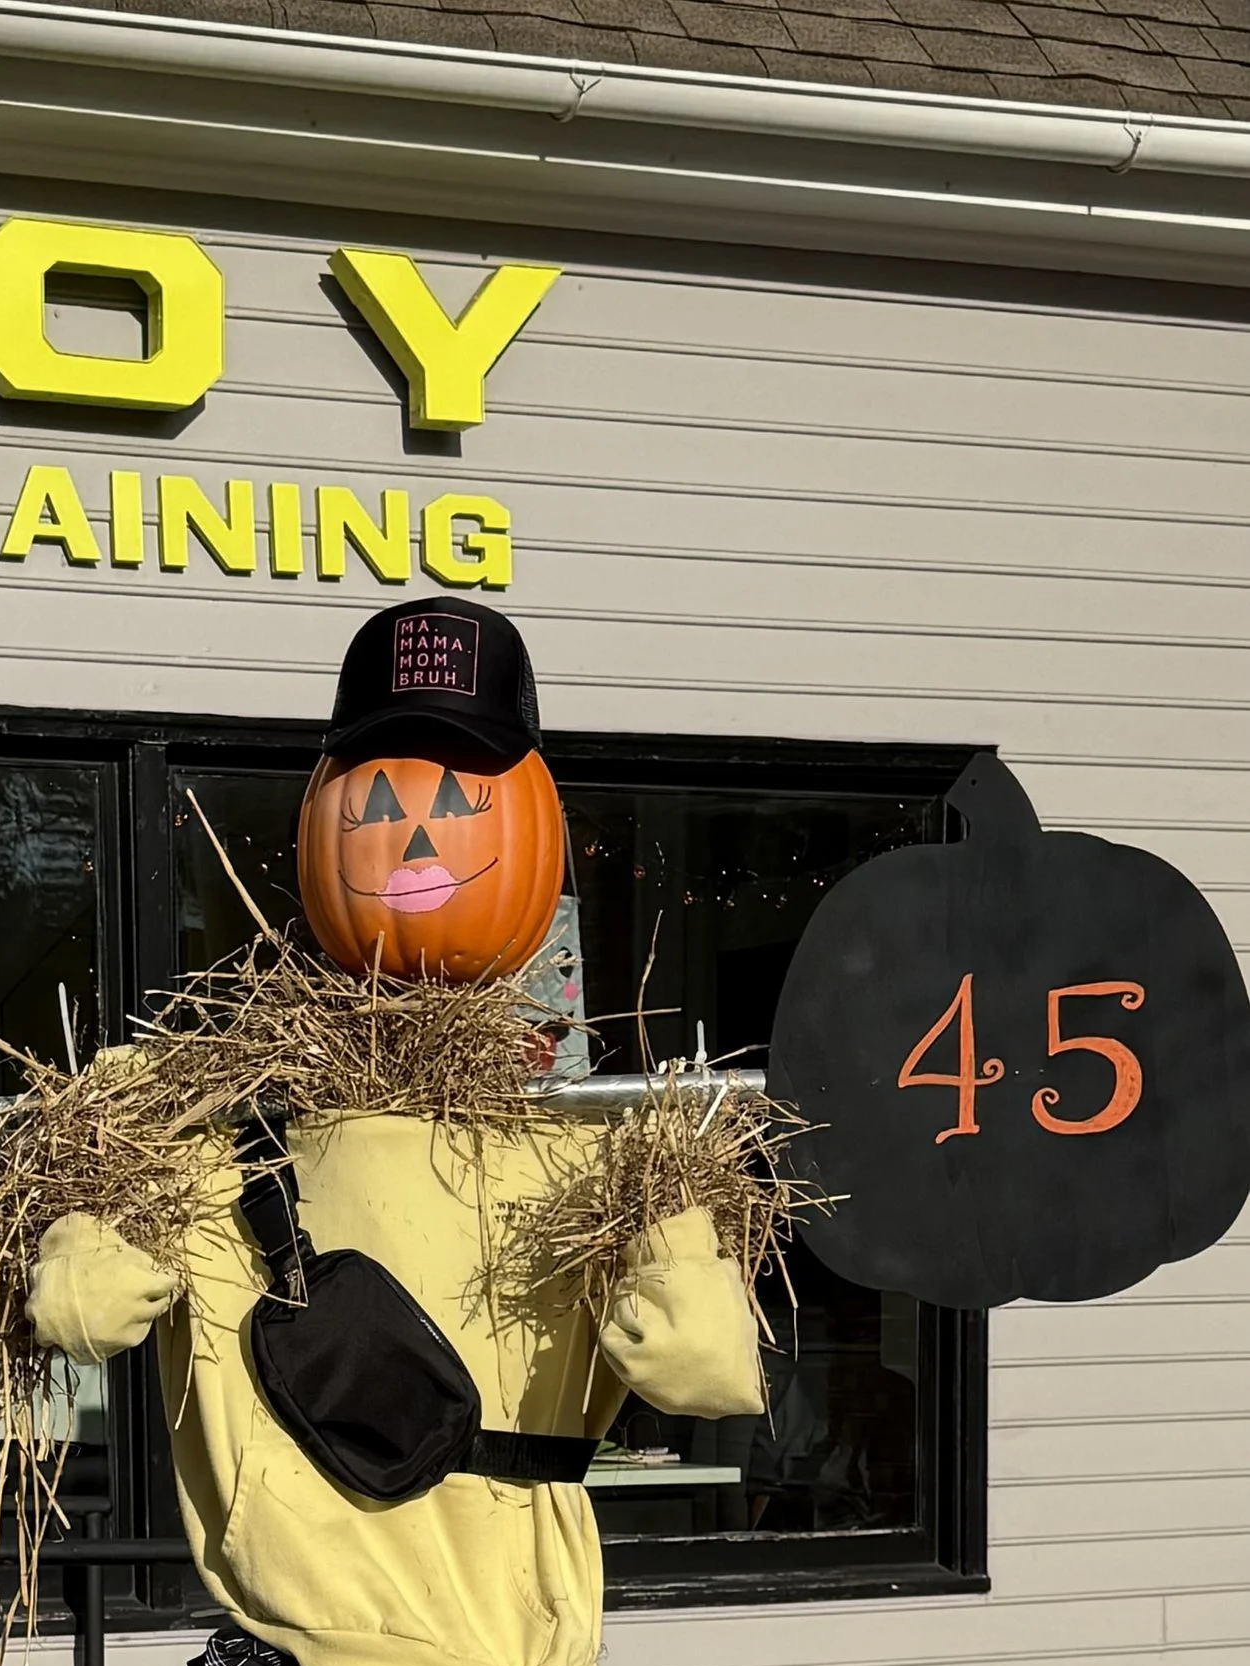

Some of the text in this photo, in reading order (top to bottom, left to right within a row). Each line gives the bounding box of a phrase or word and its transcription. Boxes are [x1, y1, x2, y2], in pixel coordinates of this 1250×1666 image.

[400, 619, 439, 635] MA.
[400, 635, 472, 654] MAMA.
[399, 653, 457, 669] MOM.
[399, 671, 466, 688] BRUH.
[897, 972, 1146, 1145] 45
